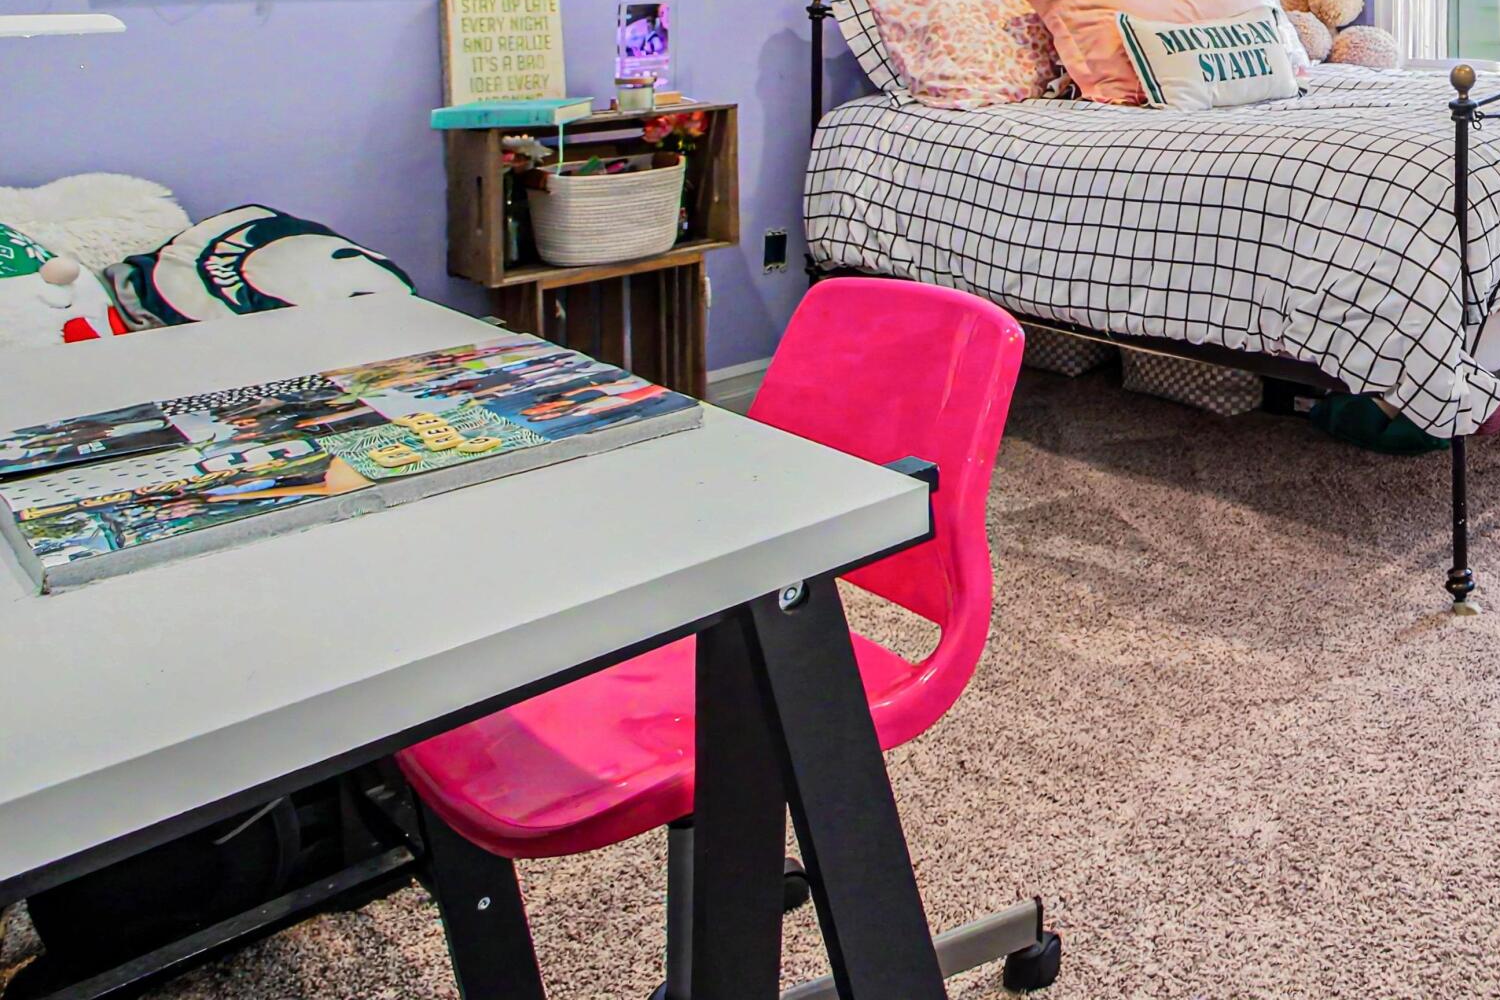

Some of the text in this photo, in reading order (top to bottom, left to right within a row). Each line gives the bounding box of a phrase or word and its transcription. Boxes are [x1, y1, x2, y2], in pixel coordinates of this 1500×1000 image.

[461, 16, 549, 33] EVERY NIGHT
[463, 35, 552, 53] AND REALIZE
[1155, 20, 1280, 55] MICHIGAN
[472, 55, 545, 72] IT'S A BAD
[1198, 48, 1273, 82] STATE
[470, 74, 550, 93] IDEA EVERY
